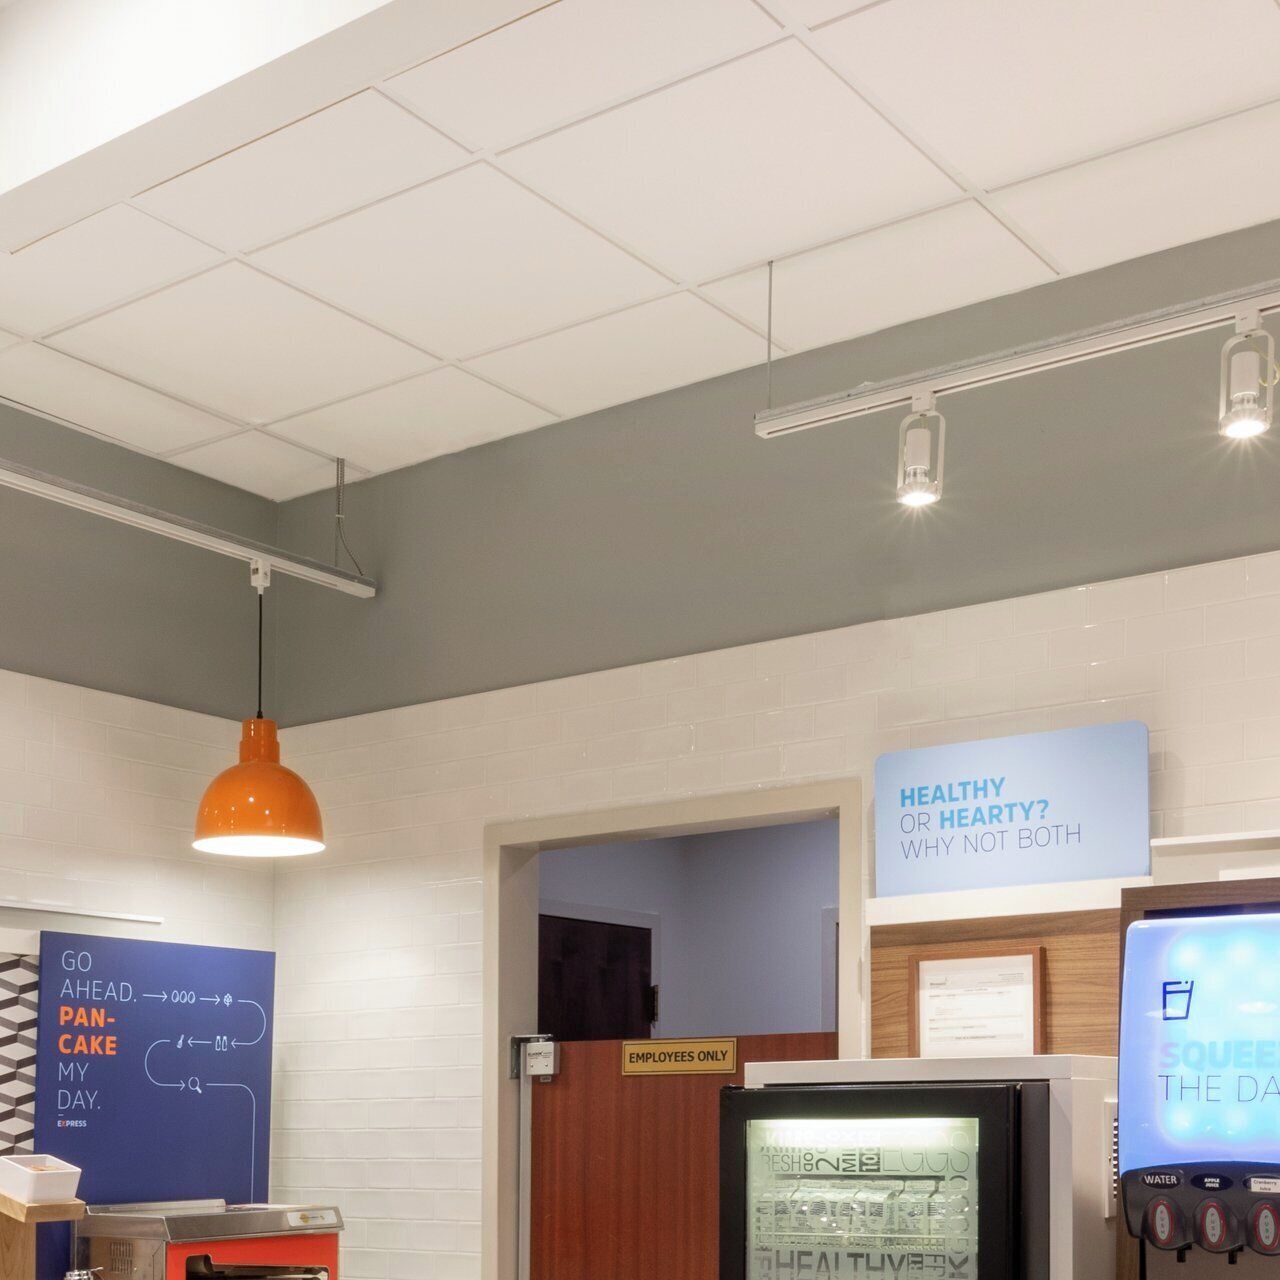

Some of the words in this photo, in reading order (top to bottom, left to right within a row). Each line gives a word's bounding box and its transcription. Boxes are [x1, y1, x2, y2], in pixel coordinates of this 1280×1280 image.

[900, 777, 1006, 808] HEALTHY
[900, 812, 931, 834] OR
[939, 799, 1050, 830] HEARTY?
[900, 836, 955, 860] WHY
[963, 830, 1009, 853] NOT
[1018, 823, 1081, 849] BOTH
[61, 950, 92, 972] GO
[59, 979, 137, 1002] AHEAD.
[59, 1006, 115, 1028] PAN-
[57, 1034, 117, 1056] CAKE
[628, 1051, 695, 1064] EMPLOYEES
[697, 1050, 729, 1062] ONLY
[57, 1062, 90, 1082] MY
[1158, 1074, 1221, 1102] THE
[57, 1090, 101, 1110] DAY.
[57, 1120, 87, 1128] EXPRESS
[883, 1131, 970, 1173] EGGS
[1144, 1175, 1178, 1184] WATER
